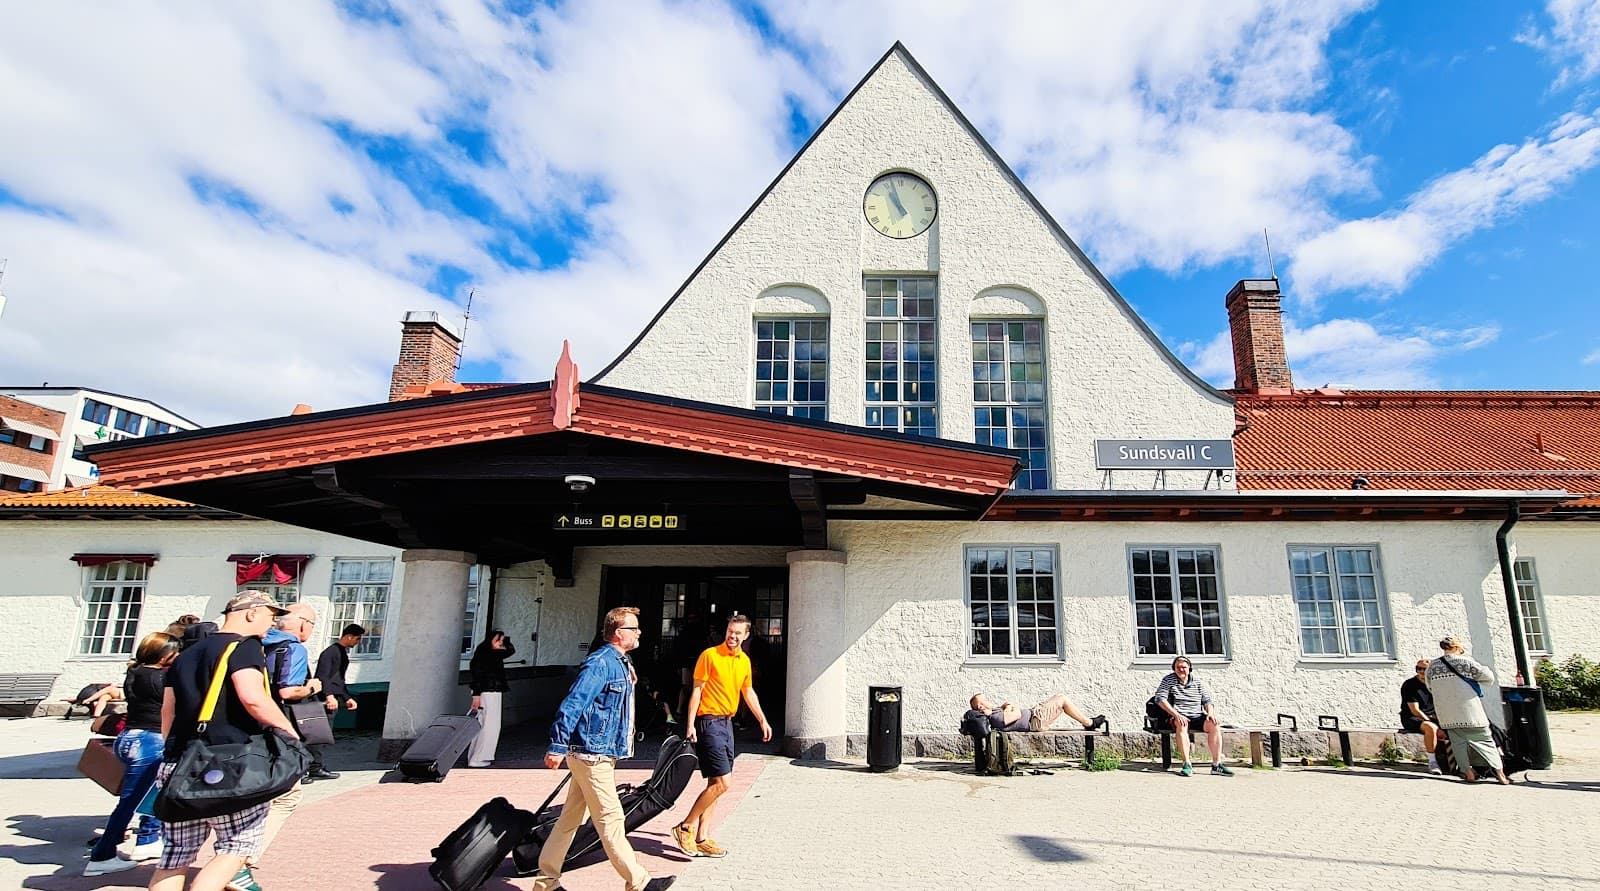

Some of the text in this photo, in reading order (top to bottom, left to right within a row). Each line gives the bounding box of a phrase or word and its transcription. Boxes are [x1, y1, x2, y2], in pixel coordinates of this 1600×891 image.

[1119, 445, 1212, 460] Sundsvall C
[573, 516, 593, 525] Buss
